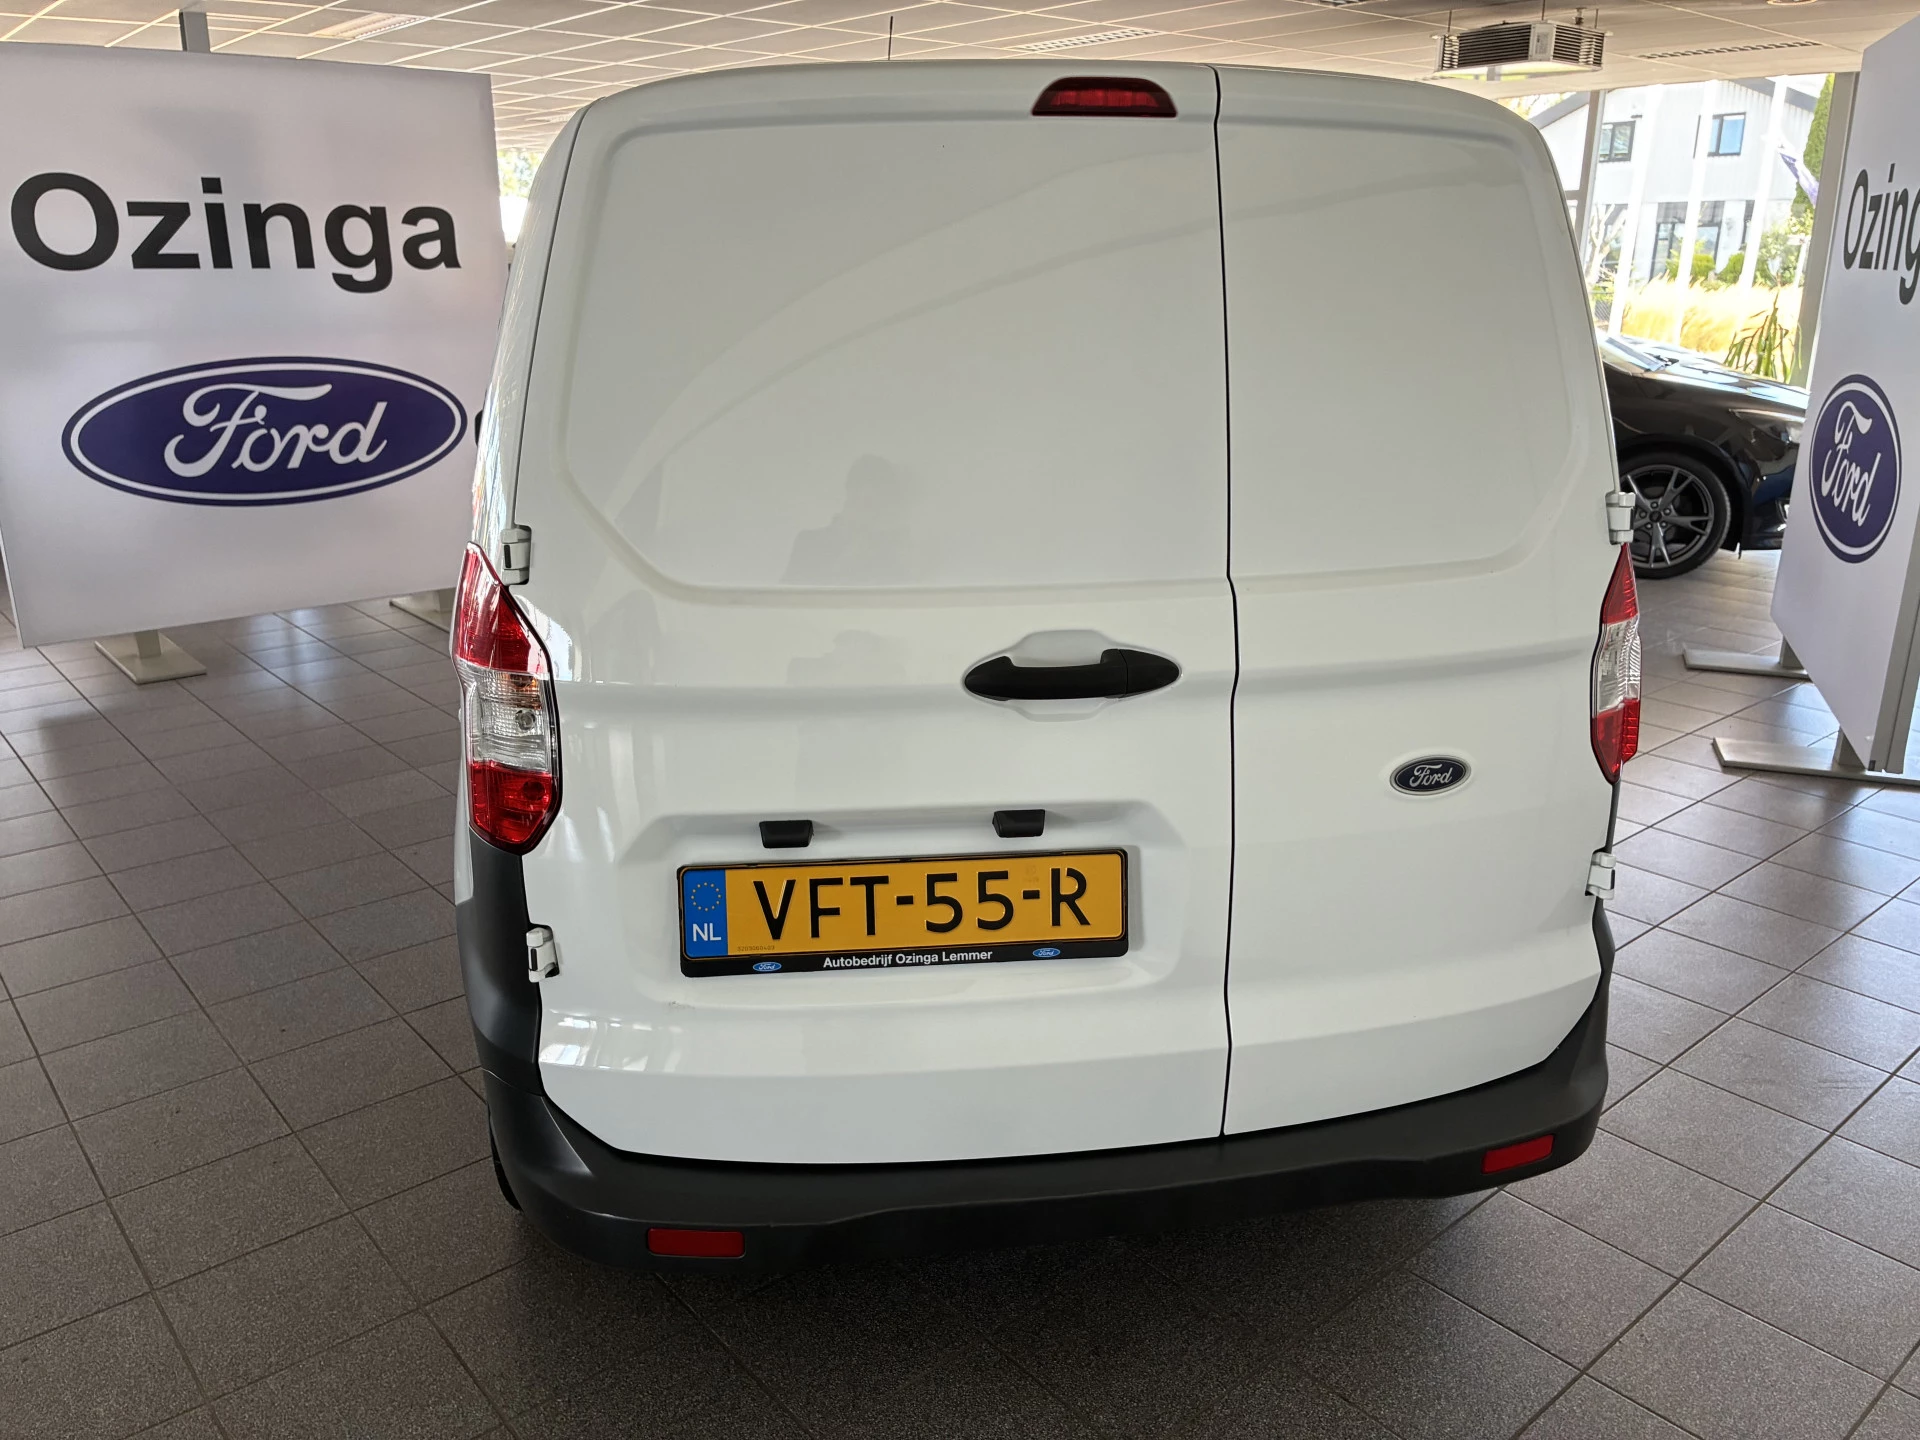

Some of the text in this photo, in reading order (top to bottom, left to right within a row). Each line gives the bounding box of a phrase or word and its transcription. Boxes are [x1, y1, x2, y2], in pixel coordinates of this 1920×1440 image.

[11, 171, 462, 293] Ozinga
[163, 382, 389, 478] Ford
[1821, 400, 1882, 528] Ford
[1409, 763, 1454, 788] Ford
[692, 922, 722, 942] NL
[752, 867, 1092, 941] VFT-55-R
[822, 949, 994, 969] Autobedrijf Ozinga Lemmer
